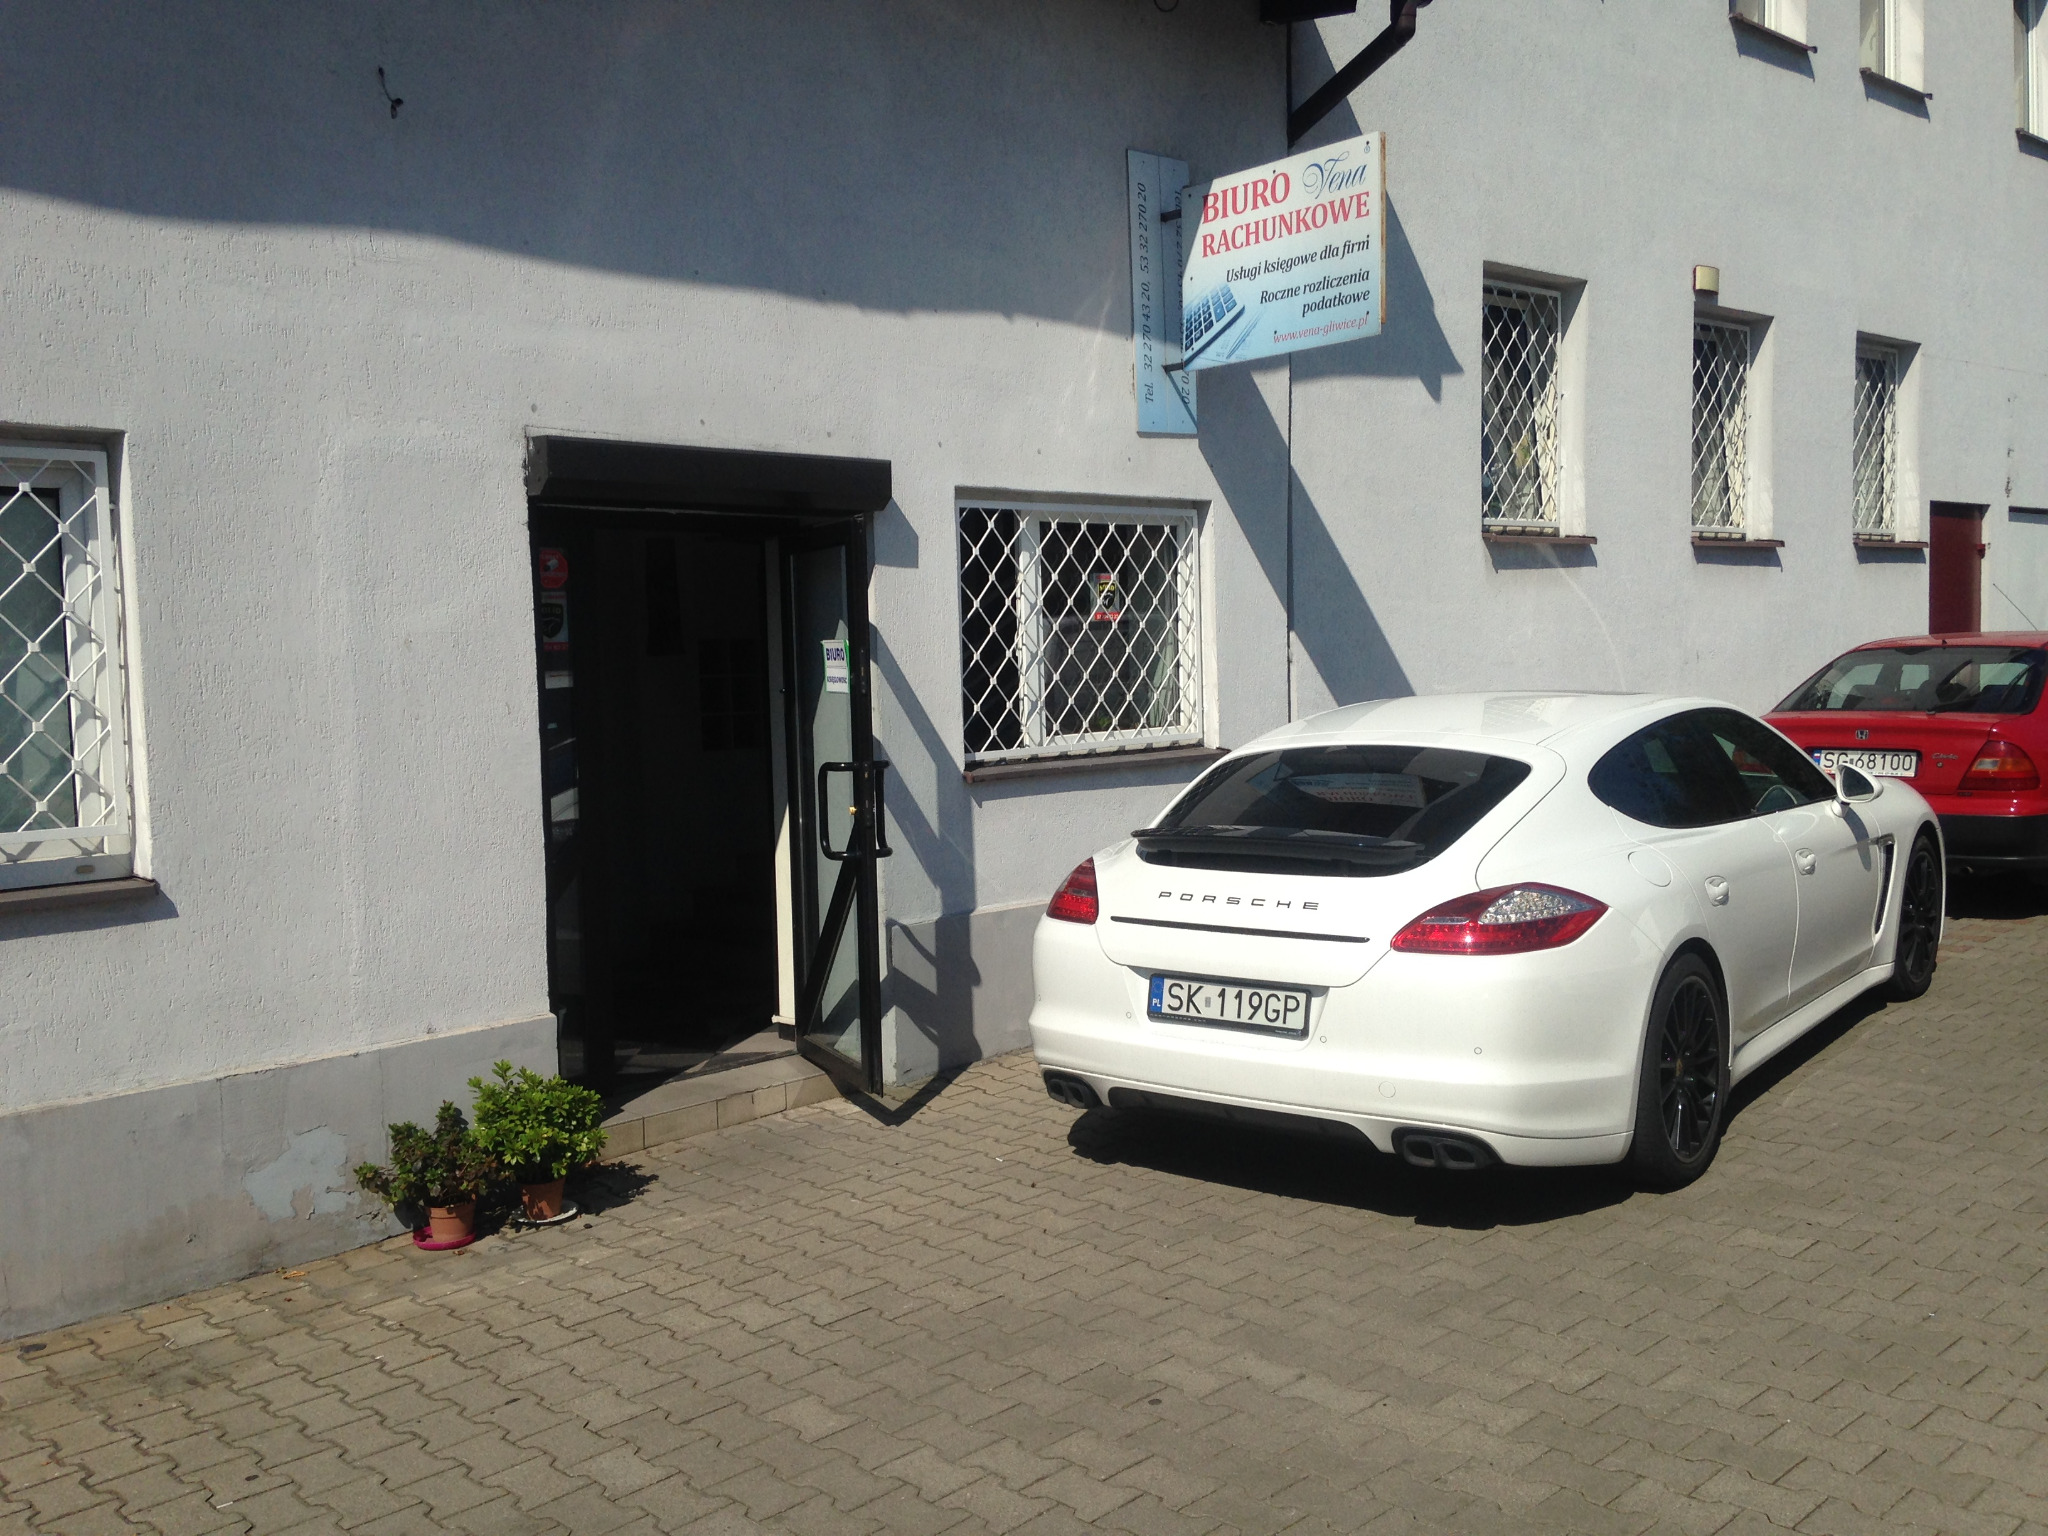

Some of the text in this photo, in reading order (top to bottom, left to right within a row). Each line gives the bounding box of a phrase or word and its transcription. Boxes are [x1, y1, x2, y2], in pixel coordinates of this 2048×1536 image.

[1302, 151, 1367, 199] Vena
[1202, 172, 1290, 224] BIURO
[1202, 191, 1370, 258] RACHUNKOWE
[1226, 238, 1370, 282] Usługi księgowe dla firm
[1137, 182, 1154, 404] Tel. 32 270 43 20, 53 32 270 20
[1260, 268, 1370, 304] Roczne rozliczenia
[1302, 289, 1370, 318] podatkowe
[1273, 315, 1368, 343] www.vena-gliwice.pl
[826, 648, 845, 661] BIURO
[1823, 751, 1913, 771] SG 68100
[1158, 891, 1319, 911] PORSCHE
[1152, 997, 1161, 1008] PL
[1167, 982, 1300, 1025] SK 119GP
